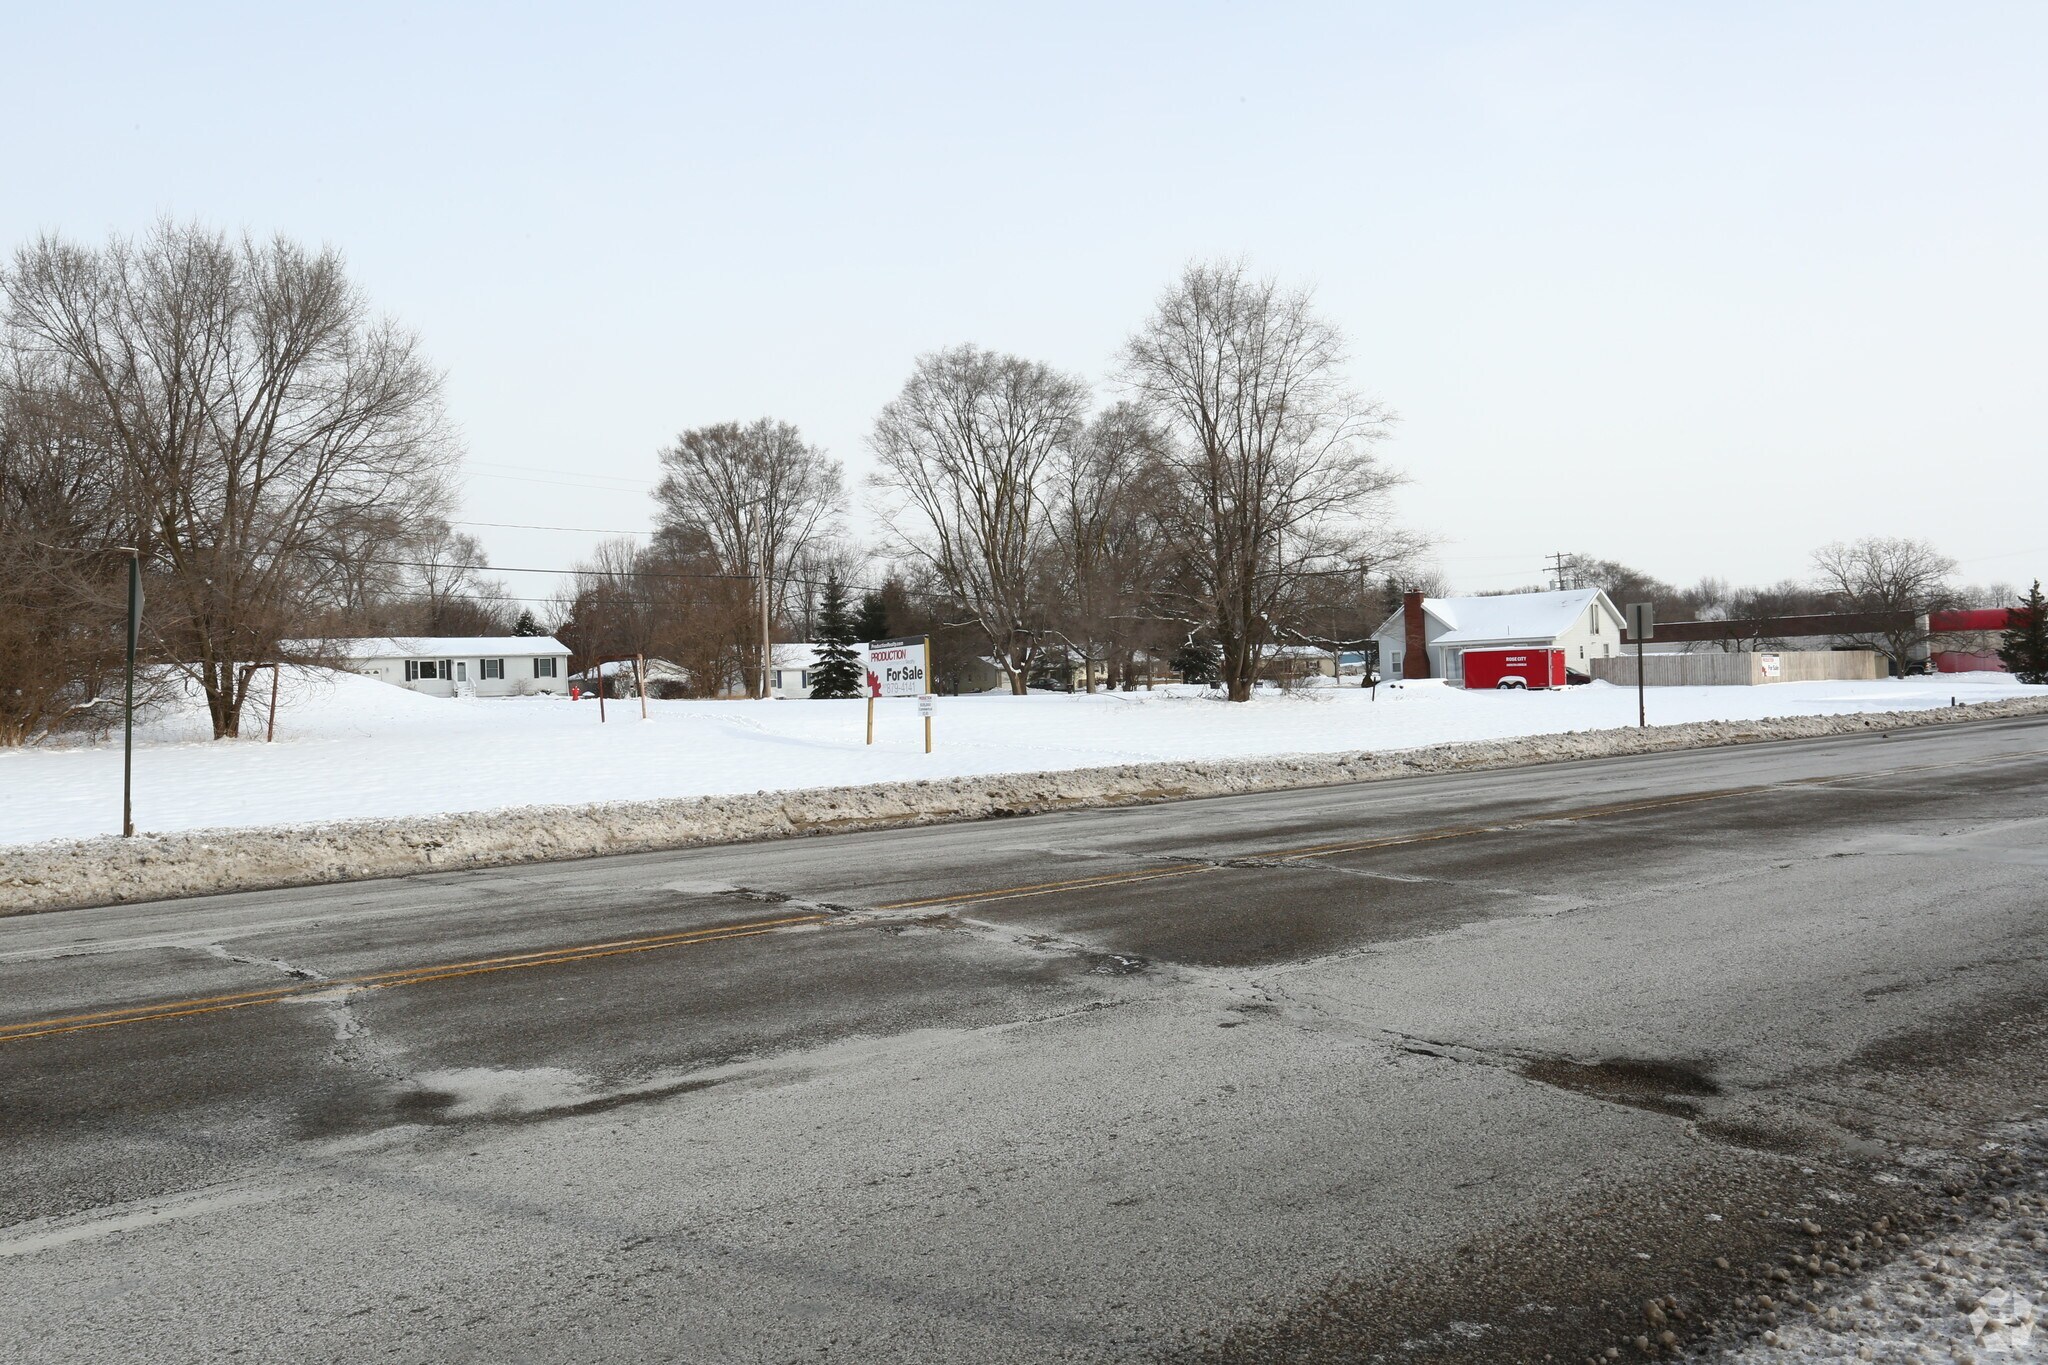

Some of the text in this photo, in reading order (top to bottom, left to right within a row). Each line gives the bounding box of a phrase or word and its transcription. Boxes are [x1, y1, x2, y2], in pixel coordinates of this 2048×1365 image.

[871, 650, 906, 662] PRODUCTION
[886, 665, 923, 681] For Sale
[887, 682, 915, 693] 879-4141
